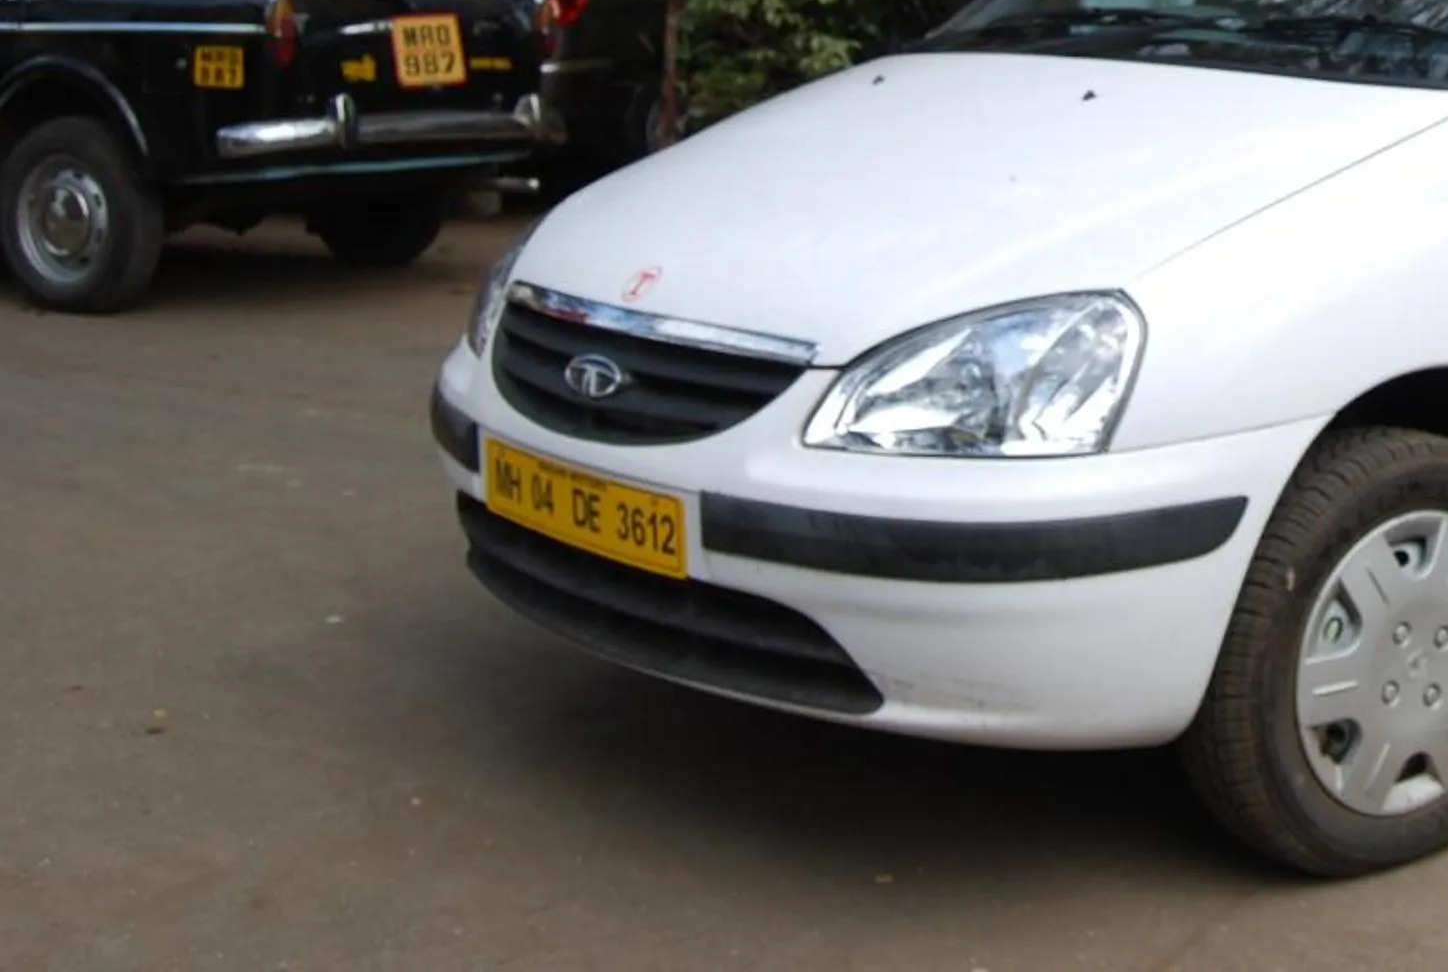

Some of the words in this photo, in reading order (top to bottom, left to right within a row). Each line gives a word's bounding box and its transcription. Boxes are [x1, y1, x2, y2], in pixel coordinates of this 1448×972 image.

[495, 458, 522, 506] MH
[531, 473, 554, 516] 04
[572, 487, 602, 533] DE
[617, 501, 676, 555] 3612
